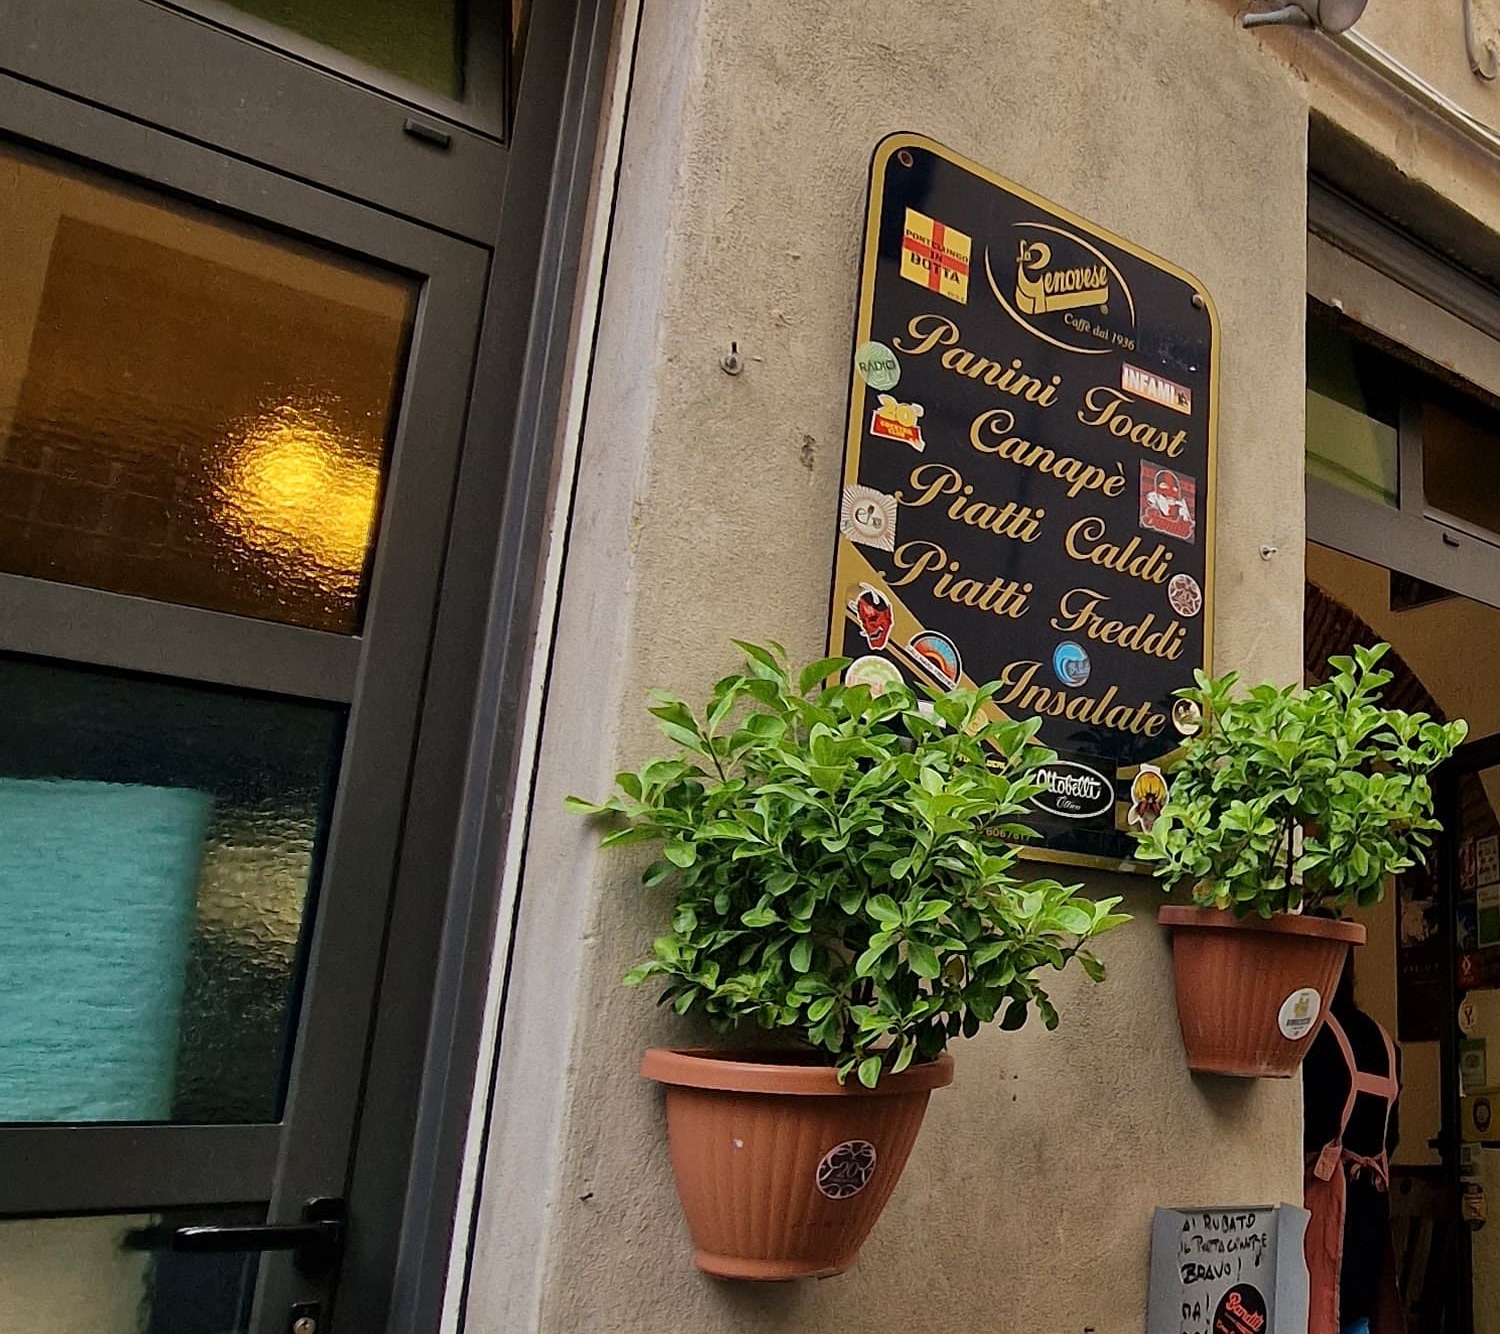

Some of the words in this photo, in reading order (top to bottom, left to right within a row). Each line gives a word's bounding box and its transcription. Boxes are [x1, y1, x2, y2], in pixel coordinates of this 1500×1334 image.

[1016, 242, 1109, 314] Genovese
[1092, 325, 1109, 340] dal
[1112, 332, 1135, 351] 1936
[892, 313, 1062, 407] Panini
[1077, 386, 1188, 458] Toast
[969, 408, 1127, 498] Canapè
[894, 463, 1046, 543] Piatti
[1065, 517, 1173, 584] Caldi
[878, 540, 1033, 618] Piatti
[1050, 588, 1188, 660] Freddi
[994, 660, 1166, 738] Insalate
